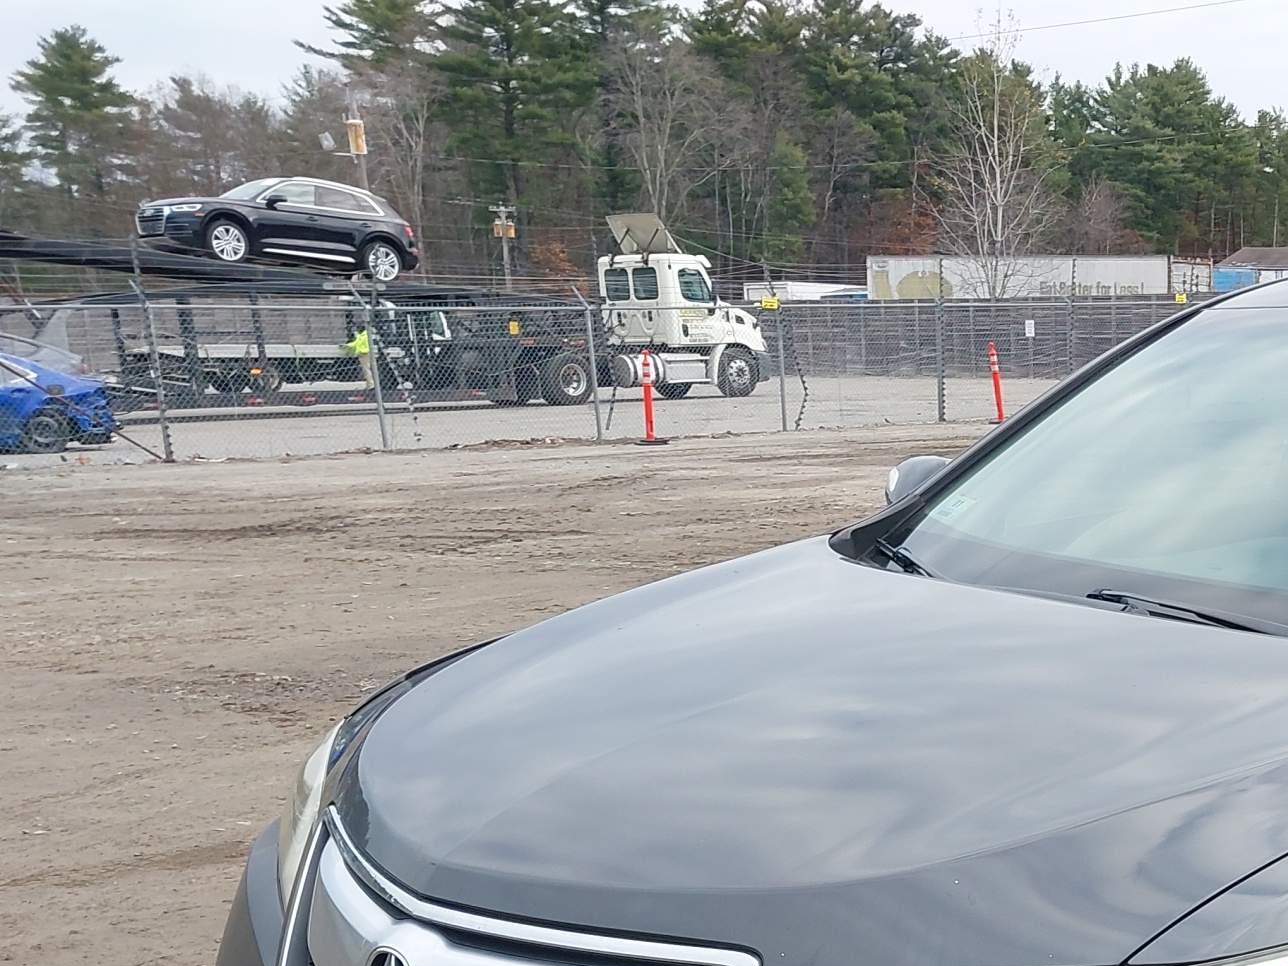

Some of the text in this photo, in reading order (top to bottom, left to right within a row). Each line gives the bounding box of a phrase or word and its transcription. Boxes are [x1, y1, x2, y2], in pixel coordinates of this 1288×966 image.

[1040, 281, 1058, 295] Eat
[1060, 281, 1093, 295] Beter
[1096, 281, 1112, 295] for
